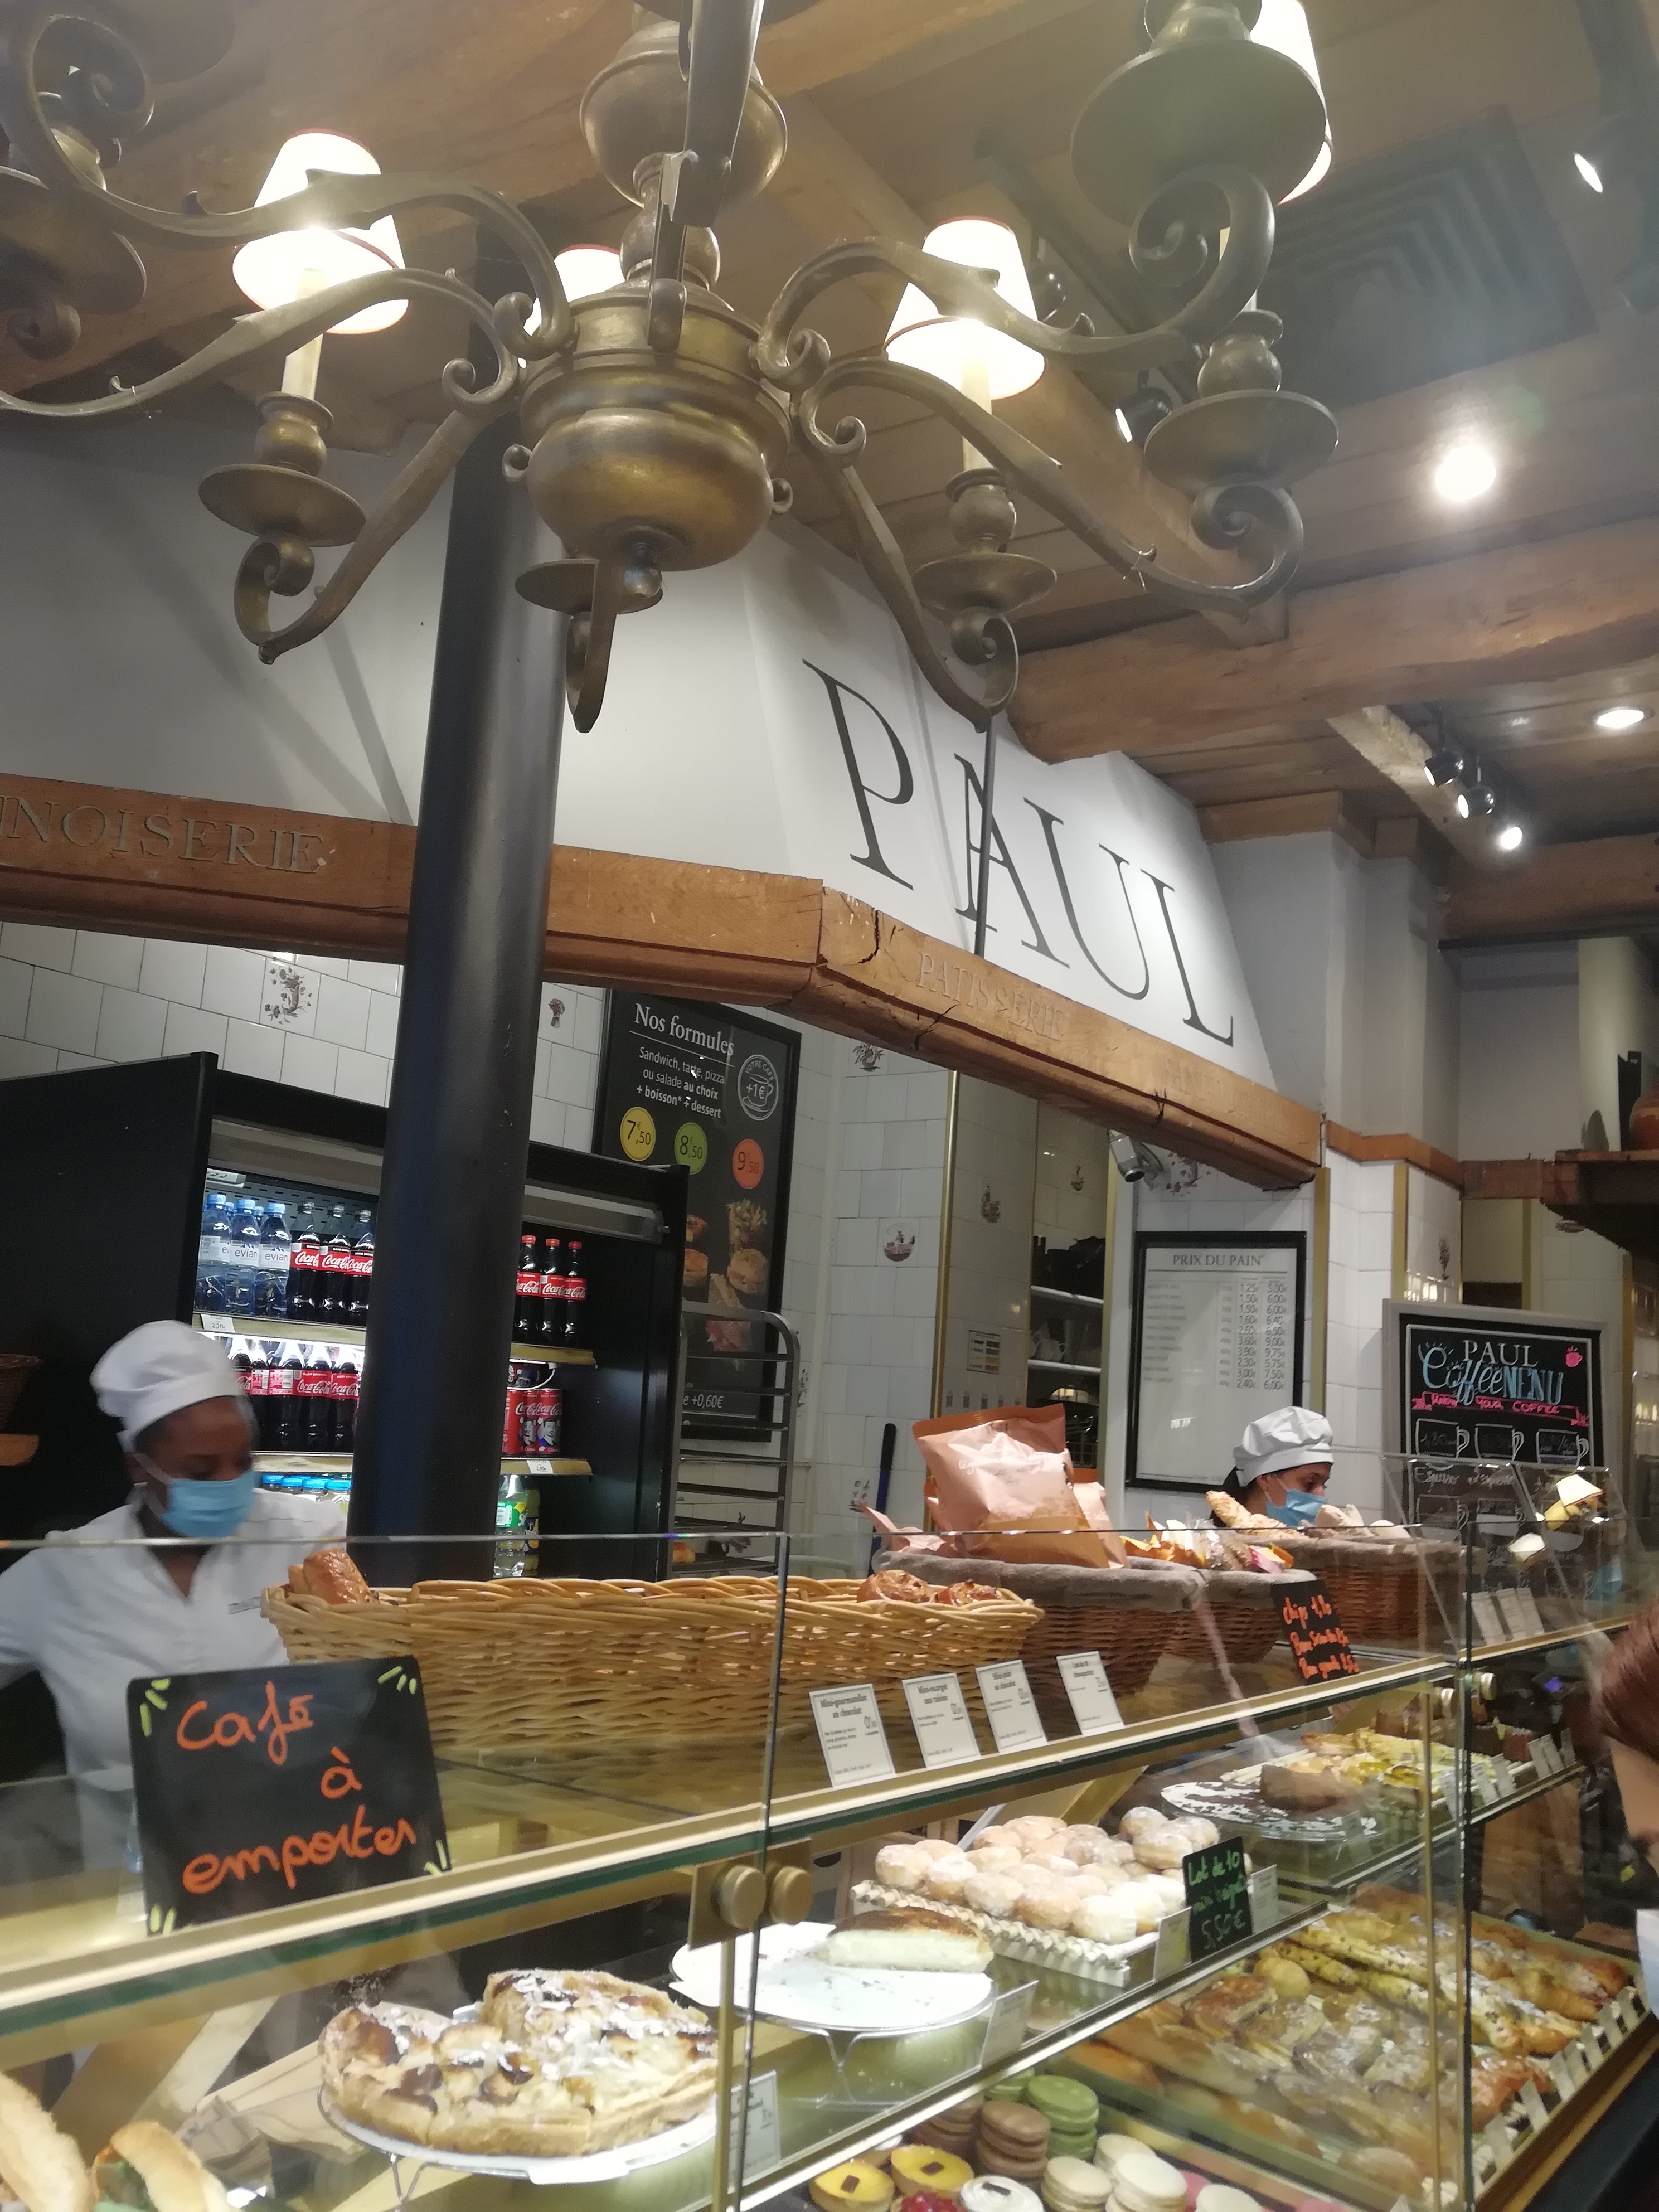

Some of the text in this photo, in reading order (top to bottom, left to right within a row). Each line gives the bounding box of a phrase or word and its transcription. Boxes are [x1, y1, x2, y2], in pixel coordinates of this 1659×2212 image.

[0, 795, 325, 874] NOISERIE
[803, 658, 1234, 1048] PAUL
[634, 1002, 734, 1056] Nos formules
[639, 1046, 681, 1071] Sandwich,
[705, 1069, 725, 1084] pizza
[643, 1069, 719, 1100] ou salade au choix
[691, 1100, 721, 1119] dessert
[746, 1083, 765, 1099] +1€
[1172, 1254, 1202, 1266] PRIX
[1205, 1254, 1226, 1266] DU
[1463, 1339, 1539, 1367] PAUL
[177, 1680, 314, 1765] Café
[320, 1746, 362, 1799] à
[182, 1804, 417, 1894] emporter
